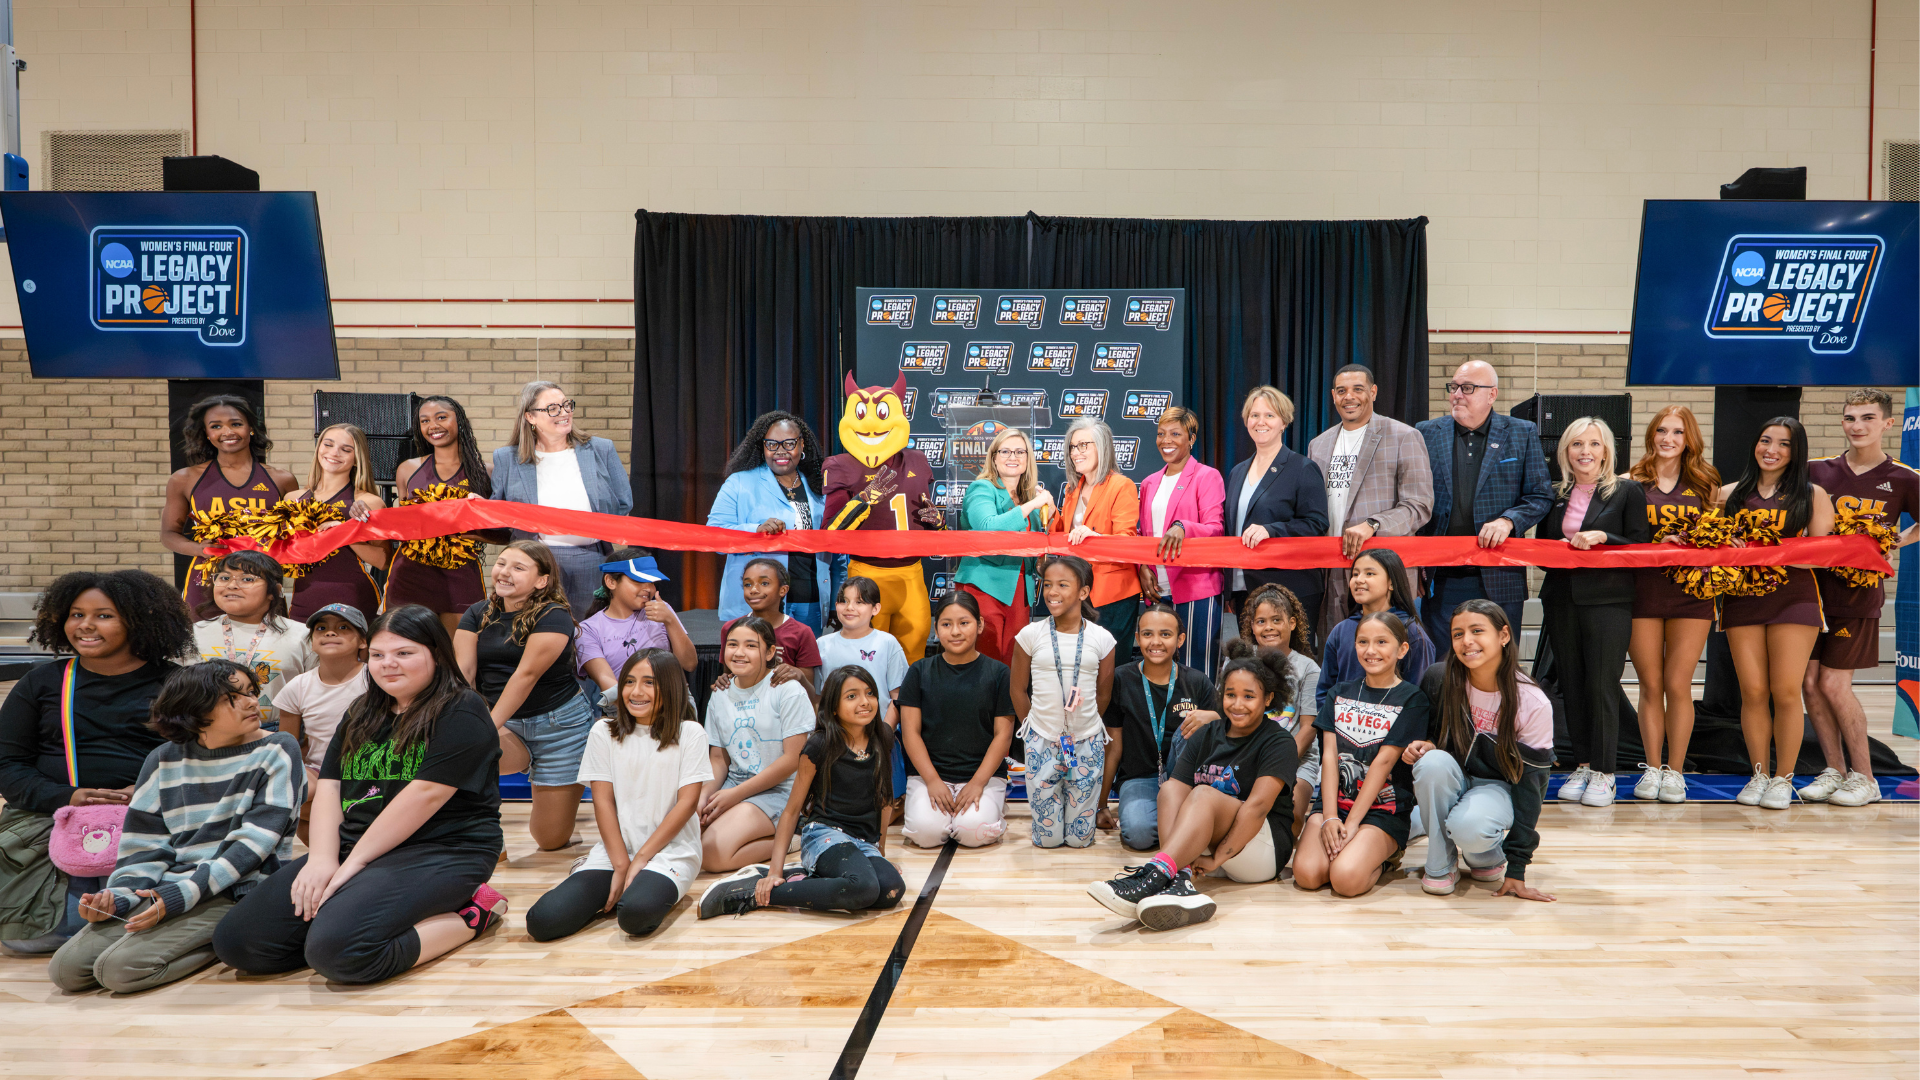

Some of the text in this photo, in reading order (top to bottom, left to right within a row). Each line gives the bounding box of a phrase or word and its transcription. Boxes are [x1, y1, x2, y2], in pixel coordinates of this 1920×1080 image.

[140, 241, 233, 252] WOMEN'S FINAL FOUR
[1775, 249, 1869, 261] WOMEN'S FINAL FOUR
[105, 259, 134, 269] NCAA
[141, 254, 233, 282] LEGACY
[1734, 267, 1764, 277] NCAA
[1767, 262, 1865, 290] LEGACY
[884, 303, 912, 311] LEGACY
[948, 303, 976, 311] LEGACY
[1012, 303, 1041, 311] LEGACY
[1141, 304, 1169, 312] LEGACY
[171, 317, 206, 325] PRESENTED BY
[208, 324, 236, 337] Dove
[1785, 325, 1821, 333] PRESENTED BY
[1819, 332, 1848, 344] Dove
[916, 349, 945, 357] LEGACY
[981, 349, 1009, 357] LEGACY
[1044, 349, 1073, 358] LEGACY
[1108, 350, 1136, 359] LEGACY
[1076, 397, 1104, 405] LEGACY
[1139, 398, 1167, 407] LEGACY
[916, 441, 945, 450] LEGACY
[952, 441, 988, 455] FINAL
[889, 493, 910, 531] 1
[1348, 705, 1388, 719] Fabulous
[1335, 712, 1392, 732] AS VEGA
[1346, 725, 1377, 736] NEVADA
[1209, 764, 1224, 775] MY
